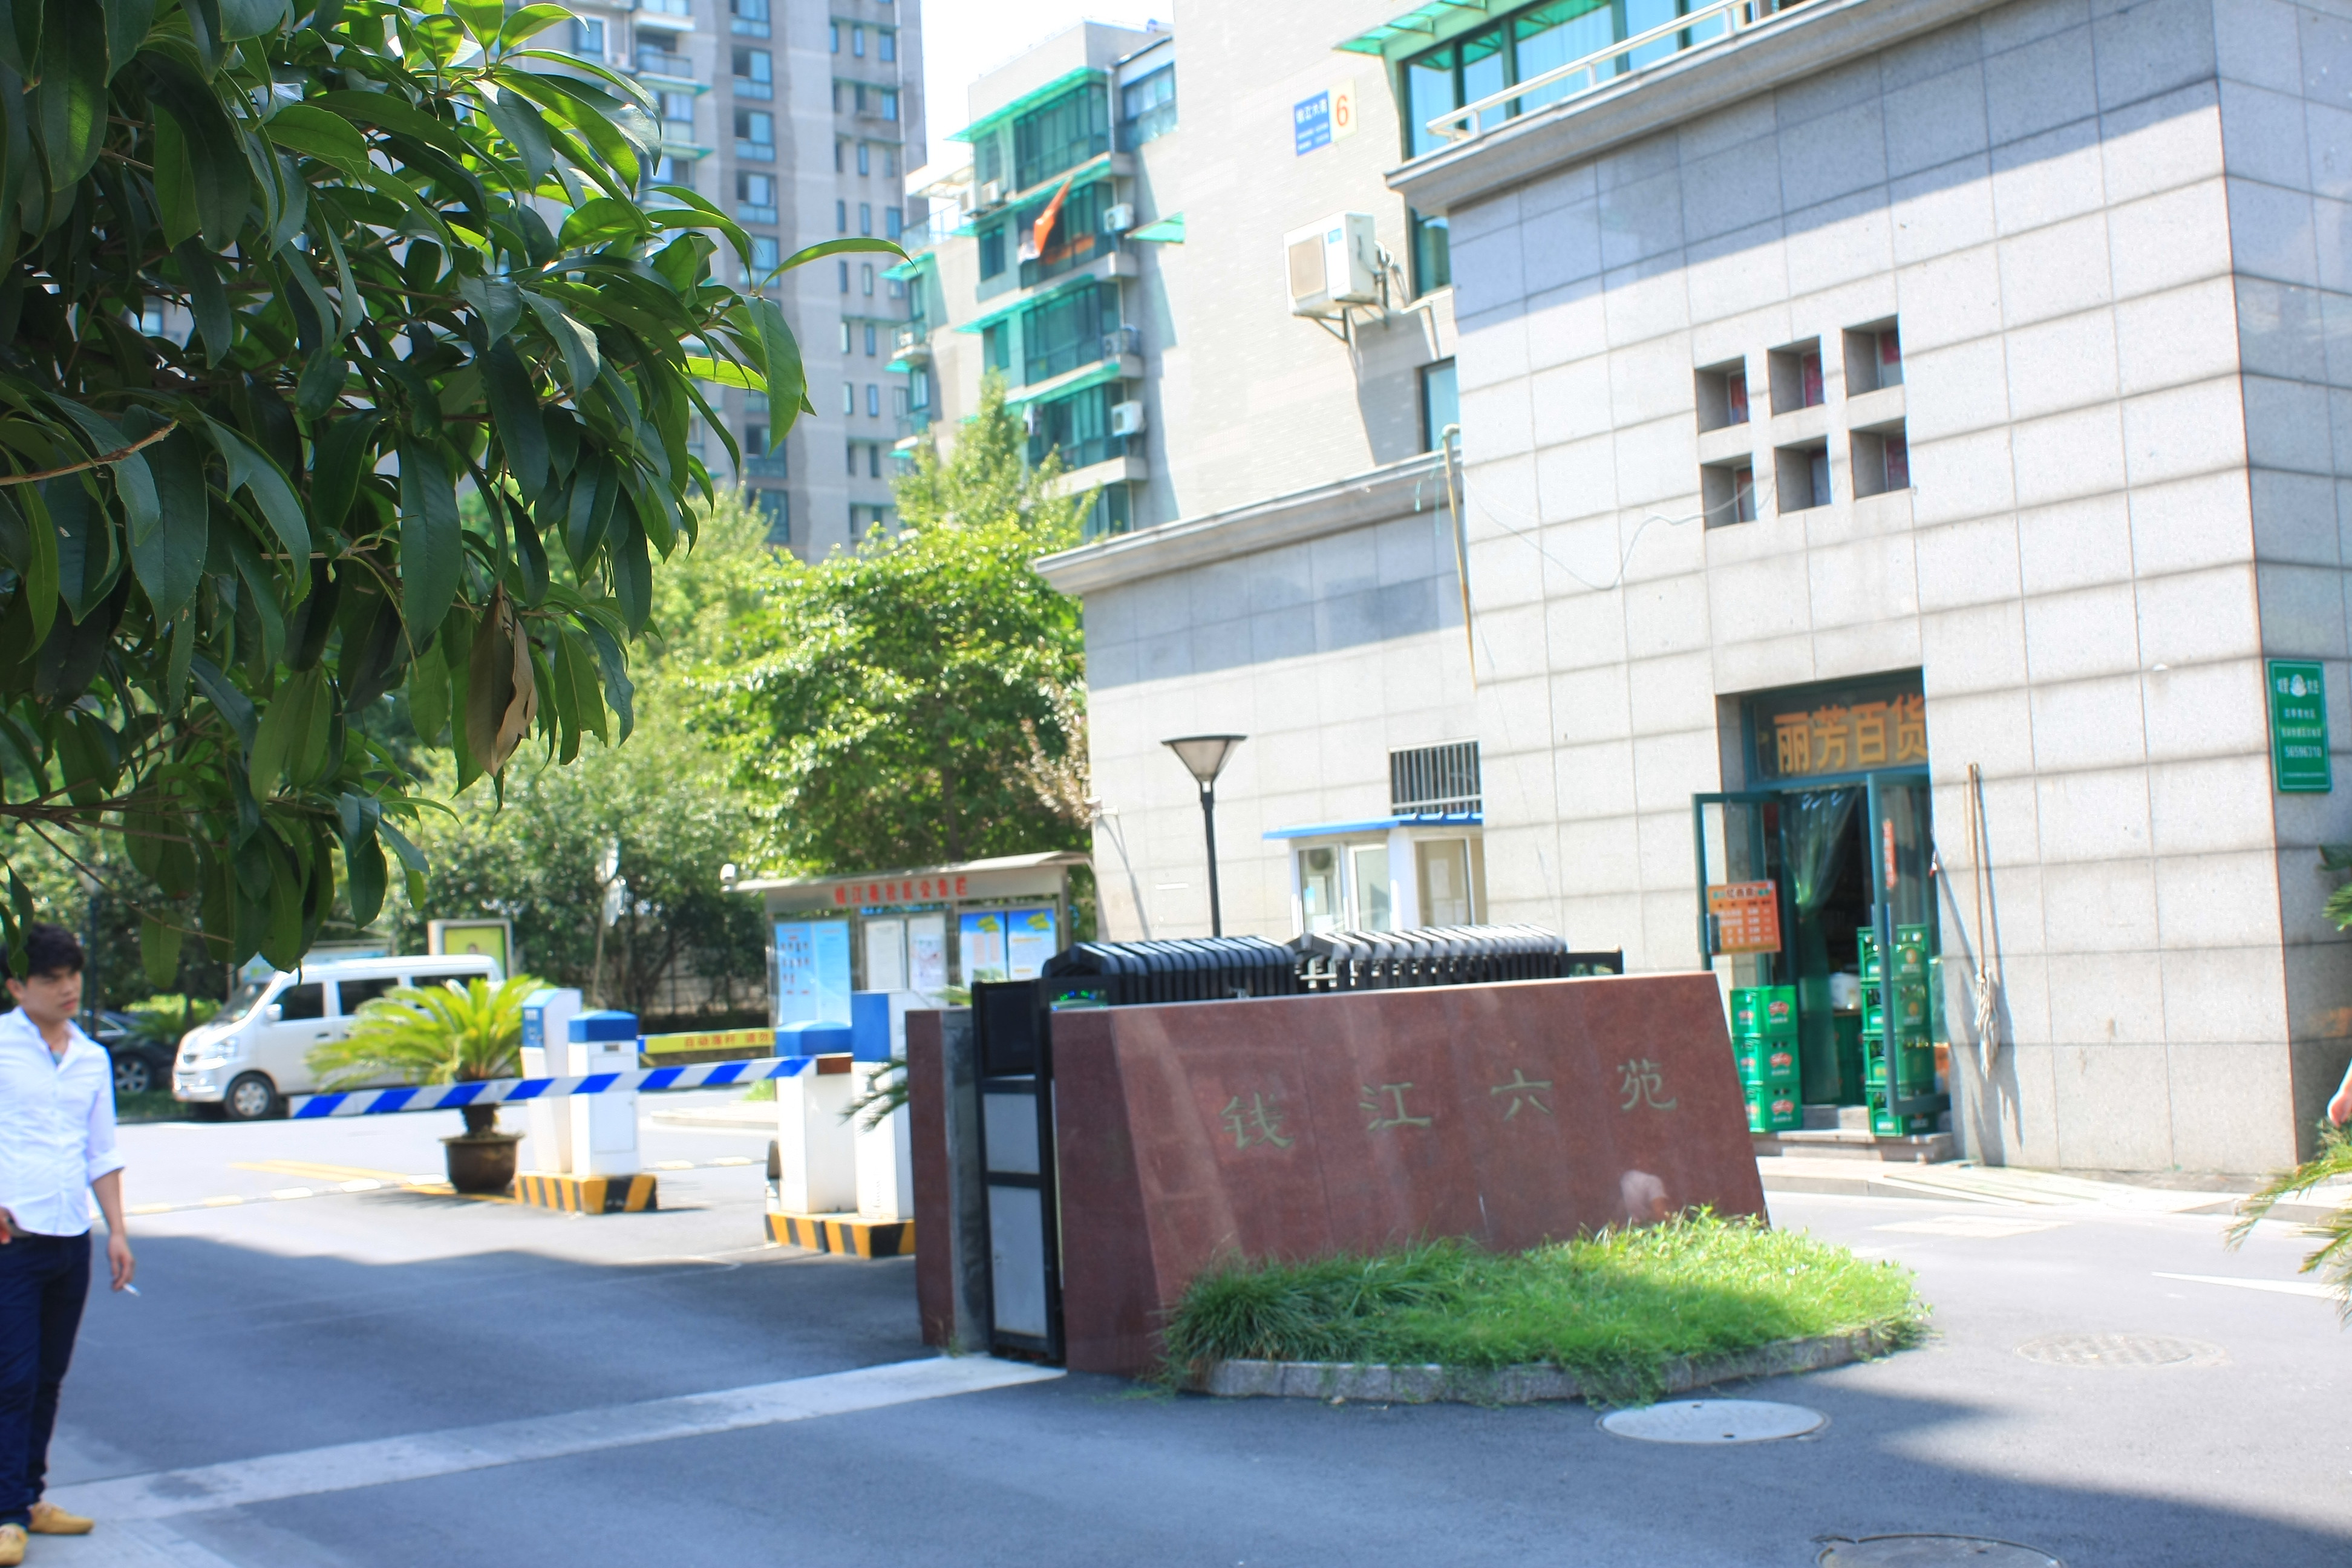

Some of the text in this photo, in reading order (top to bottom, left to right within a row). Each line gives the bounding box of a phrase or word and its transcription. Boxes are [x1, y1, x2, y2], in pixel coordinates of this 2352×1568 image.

[1336, 94, 1349, 126] 6
[1774, 694, 1927, 773] 丽芳百货
[1220, 1058, 1677, 1151] 钱江六苑
